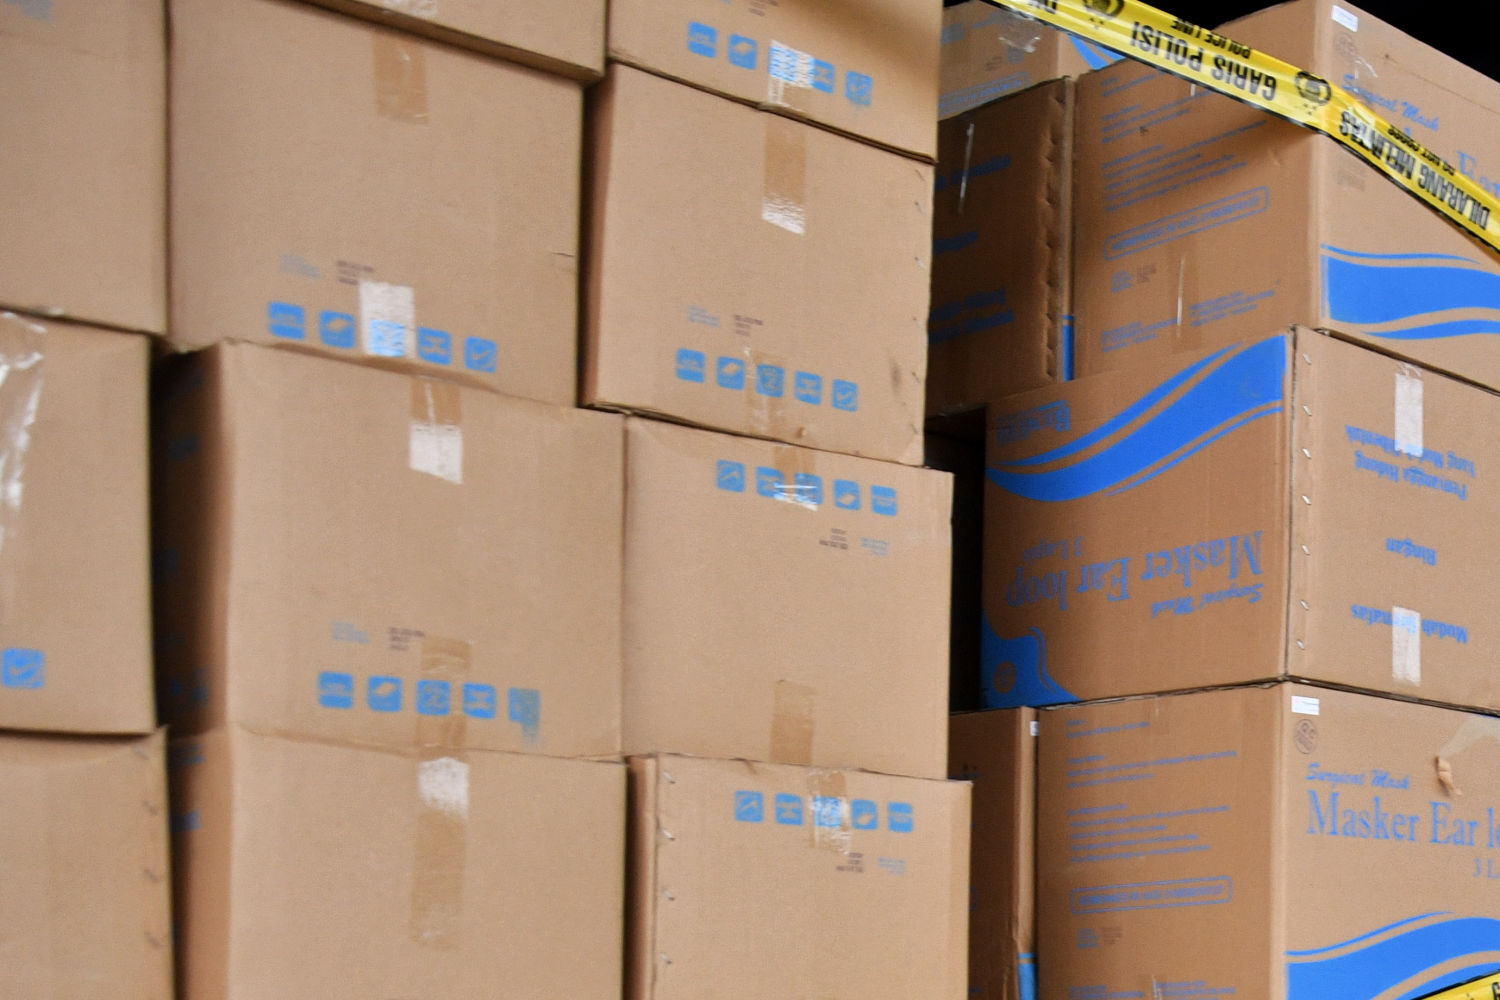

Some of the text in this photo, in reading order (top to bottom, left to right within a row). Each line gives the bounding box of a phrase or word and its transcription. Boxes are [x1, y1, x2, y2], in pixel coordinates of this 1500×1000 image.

[1130, 21, 1204, 72] POLISI
[1204, 32, 1252, 60] POLICE
[1212, 55, 1276, 101] GARIS
[1338, 111, 1491, 230] DILARANG MELINTAS
[1005, 530, 1264, 612] Masker Ear loop
[1306, 789, 1420, 843] Masker
[1429, 800, 1479, 847] Ear
[1473, 858, 1482, 877] 3
